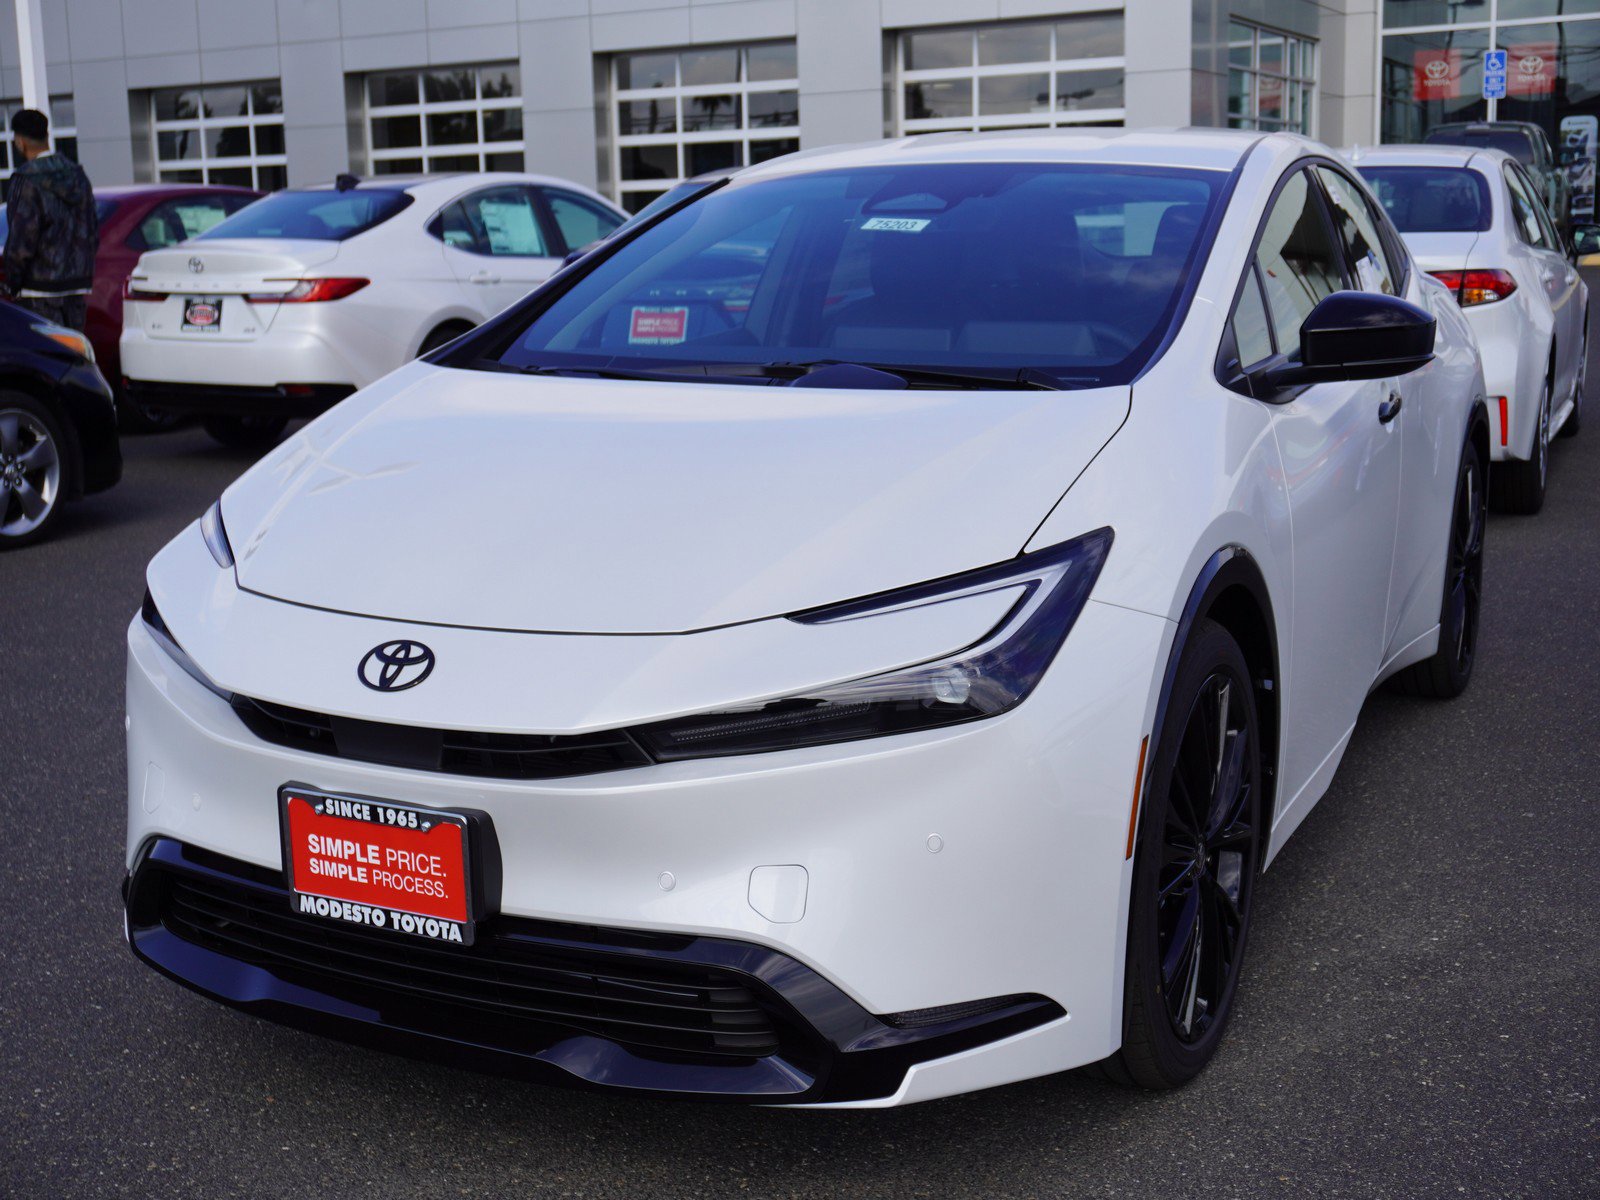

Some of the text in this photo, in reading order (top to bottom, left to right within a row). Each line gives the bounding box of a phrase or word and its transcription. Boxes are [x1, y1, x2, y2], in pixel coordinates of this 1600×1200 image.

[1423, 79, 1451, 87] TOYOTA
[871, 220, 918, 230] 75203
[325, 798, 418, 828] SINCE 1965
[308, 833, 447, 877] SIMPLE PRICE.
[309, 858, 449, 899] SIMPLE PROCESS.
[300, 894, 463, 943] MODESTO TOYOTA
